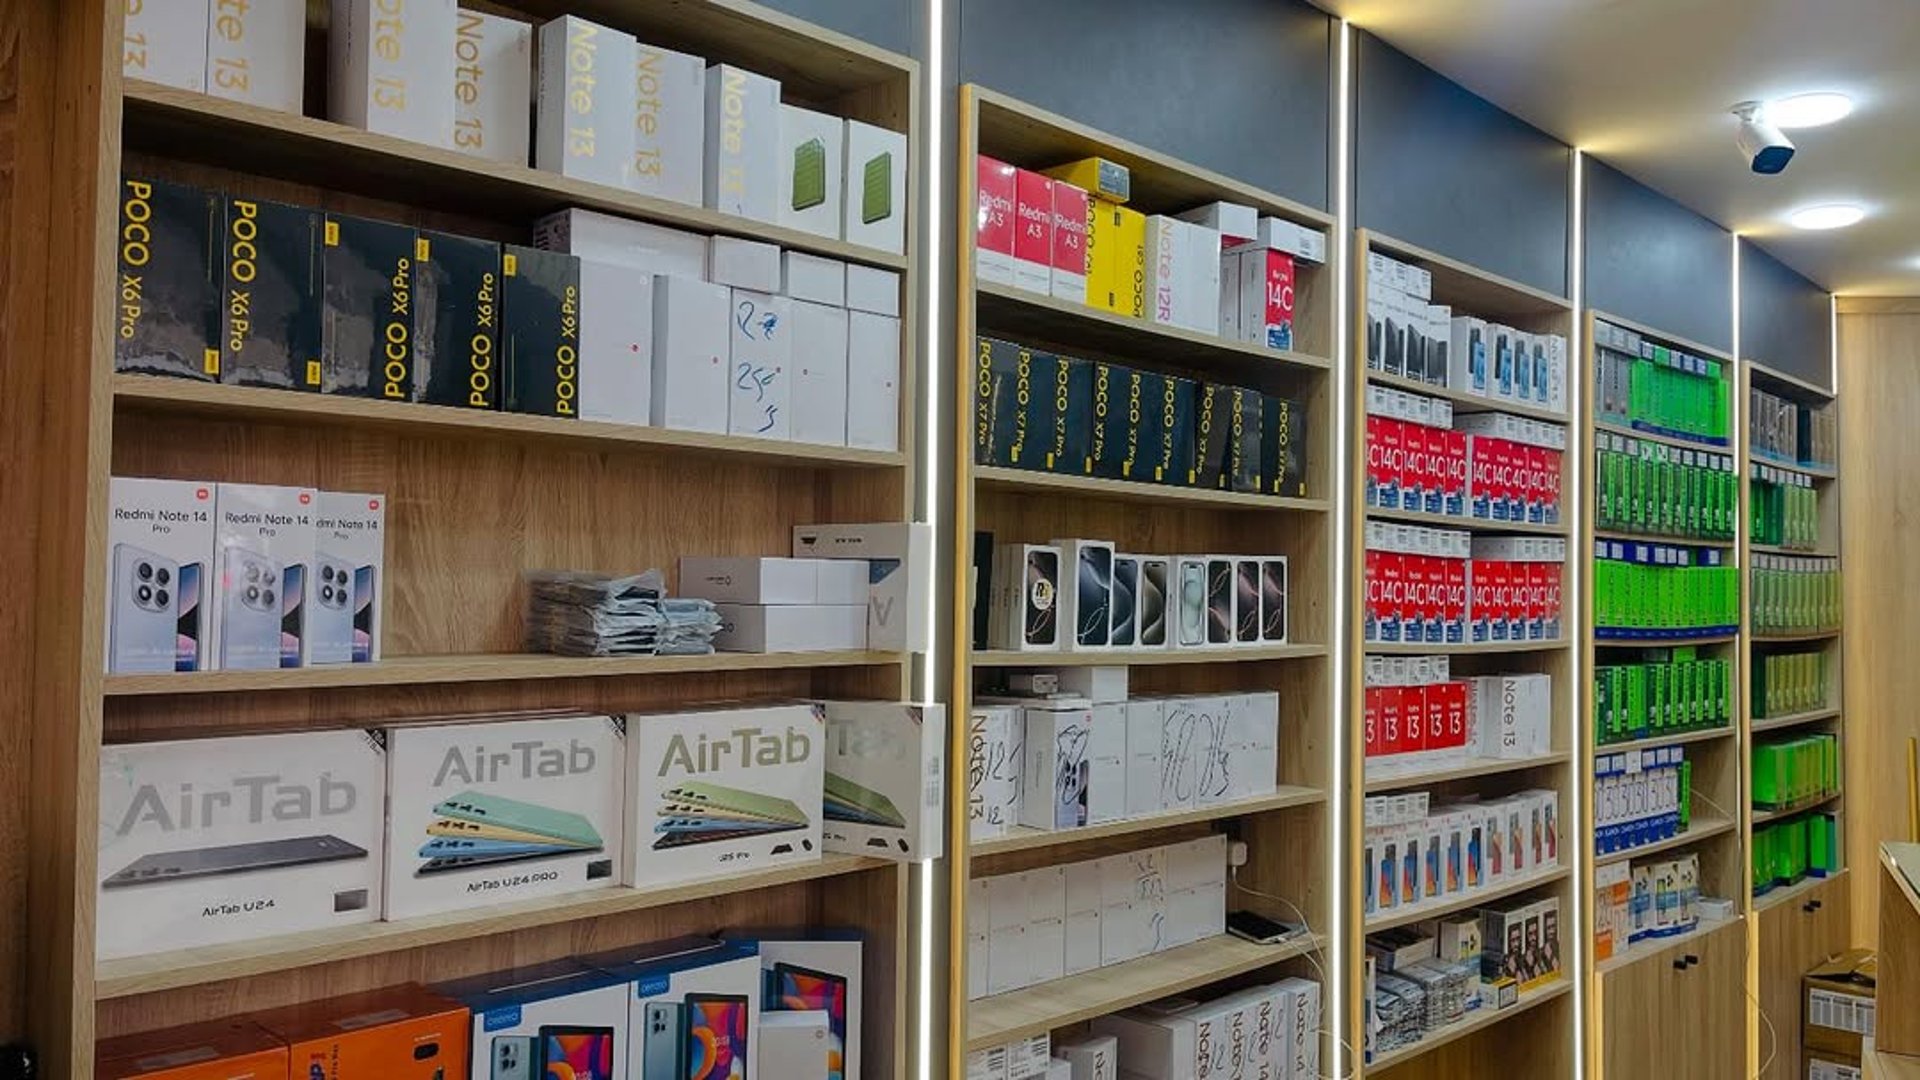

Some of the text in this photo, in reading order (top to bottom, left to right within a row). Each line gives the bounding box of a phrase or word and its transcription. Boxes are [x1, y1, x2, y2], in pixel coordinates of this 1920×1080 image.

[374, 0, 407, 112] ote 13
[214, 58, 249, 92] 13
[453, 12, 485, 151] Note 13
[567, 24, 599, 159] Note 13
[635, 50, 664, 178] Note 13
[721, 69, 748, 154] Note
[124, 180, 152, 267] POCO
[987, 211, 1004, 227] A3
[1018, 201, 1051, 225] Redmi
[231, 200, 257, 283] POCO
[1026, 223, 1043, 239] A3
[1064, 233, 1079, 249] A3
[1158, 221, 1173, 322] Note 12R
[1133, 270, 1142, 318] POCO
[1267, 281, 1294, 312] 14C
[385, 322, 408, 398] POCO
[470, 334, 492, 406] POCO
[557, 345, 576, 415] POCO
[1017, 350, 1030, 405] POCO
[979, 341, 991, 445] POCO X7 Pro
[1130, 374, 1140, 423] POCO
[1164, 379, 1174, 427] POCO
[1056, 359, 1069, 457] POCO X7 Pro
[1094, 365, 1108, 461] POCO X7 Pro
[1202, 386, 1214, 434] POCO
[1233, 390, 1242, 436] POCO
[1279, 402, 1288, 445] POCO
[1380, 445, 1402, 471] 14C
[1403, 450, 1424, 475] 14C
[1425, 454, 1446, 478] 14C
[1446, 456, 1466, 480] 14C
[1473, 461, 1492, 485] 14C
[1493, 464, 1512, 487] 14C
[115, 508, 207, 523] Redmi Note 14
[152, 523, 170, 534] Pro
[225, 511, 309, 526] Redmi Note 14
[315, 518, 378, 530] dmi Note 14
[259, 526, 276, 538] Pro
[1380, 580, 1403, 604] 14C
[1404, 582, 1424, 605] 14C
[1425, 584, 1446, 606] 14C
[1446, 585, 1466, 607] 14C
[1473, 585, 1491, 607] 14C
[1492, 585, 1510, 607] 14C
[1511, 585, 1528, 607] 14C
[1430, 713, 1443, 737] 13
[1449, 711, 1461, 735] 13
[1503, 680, 1516, 747] Note 13
[1365, 718, 1375, 744] 3
[1384, 717, 1398, 741] 13
[1407, 715, 1420, 739] 13
[433, 738, 597, 787] AirTab
[657, 725, 812, 777] AirTab
[115, 771, 357, 837] AirTab
[969, 794, 984, 820] 13
[466, 871, 559, 893] AirTab U24 PRO
[201, 899, 275, 917] AirTab U24
